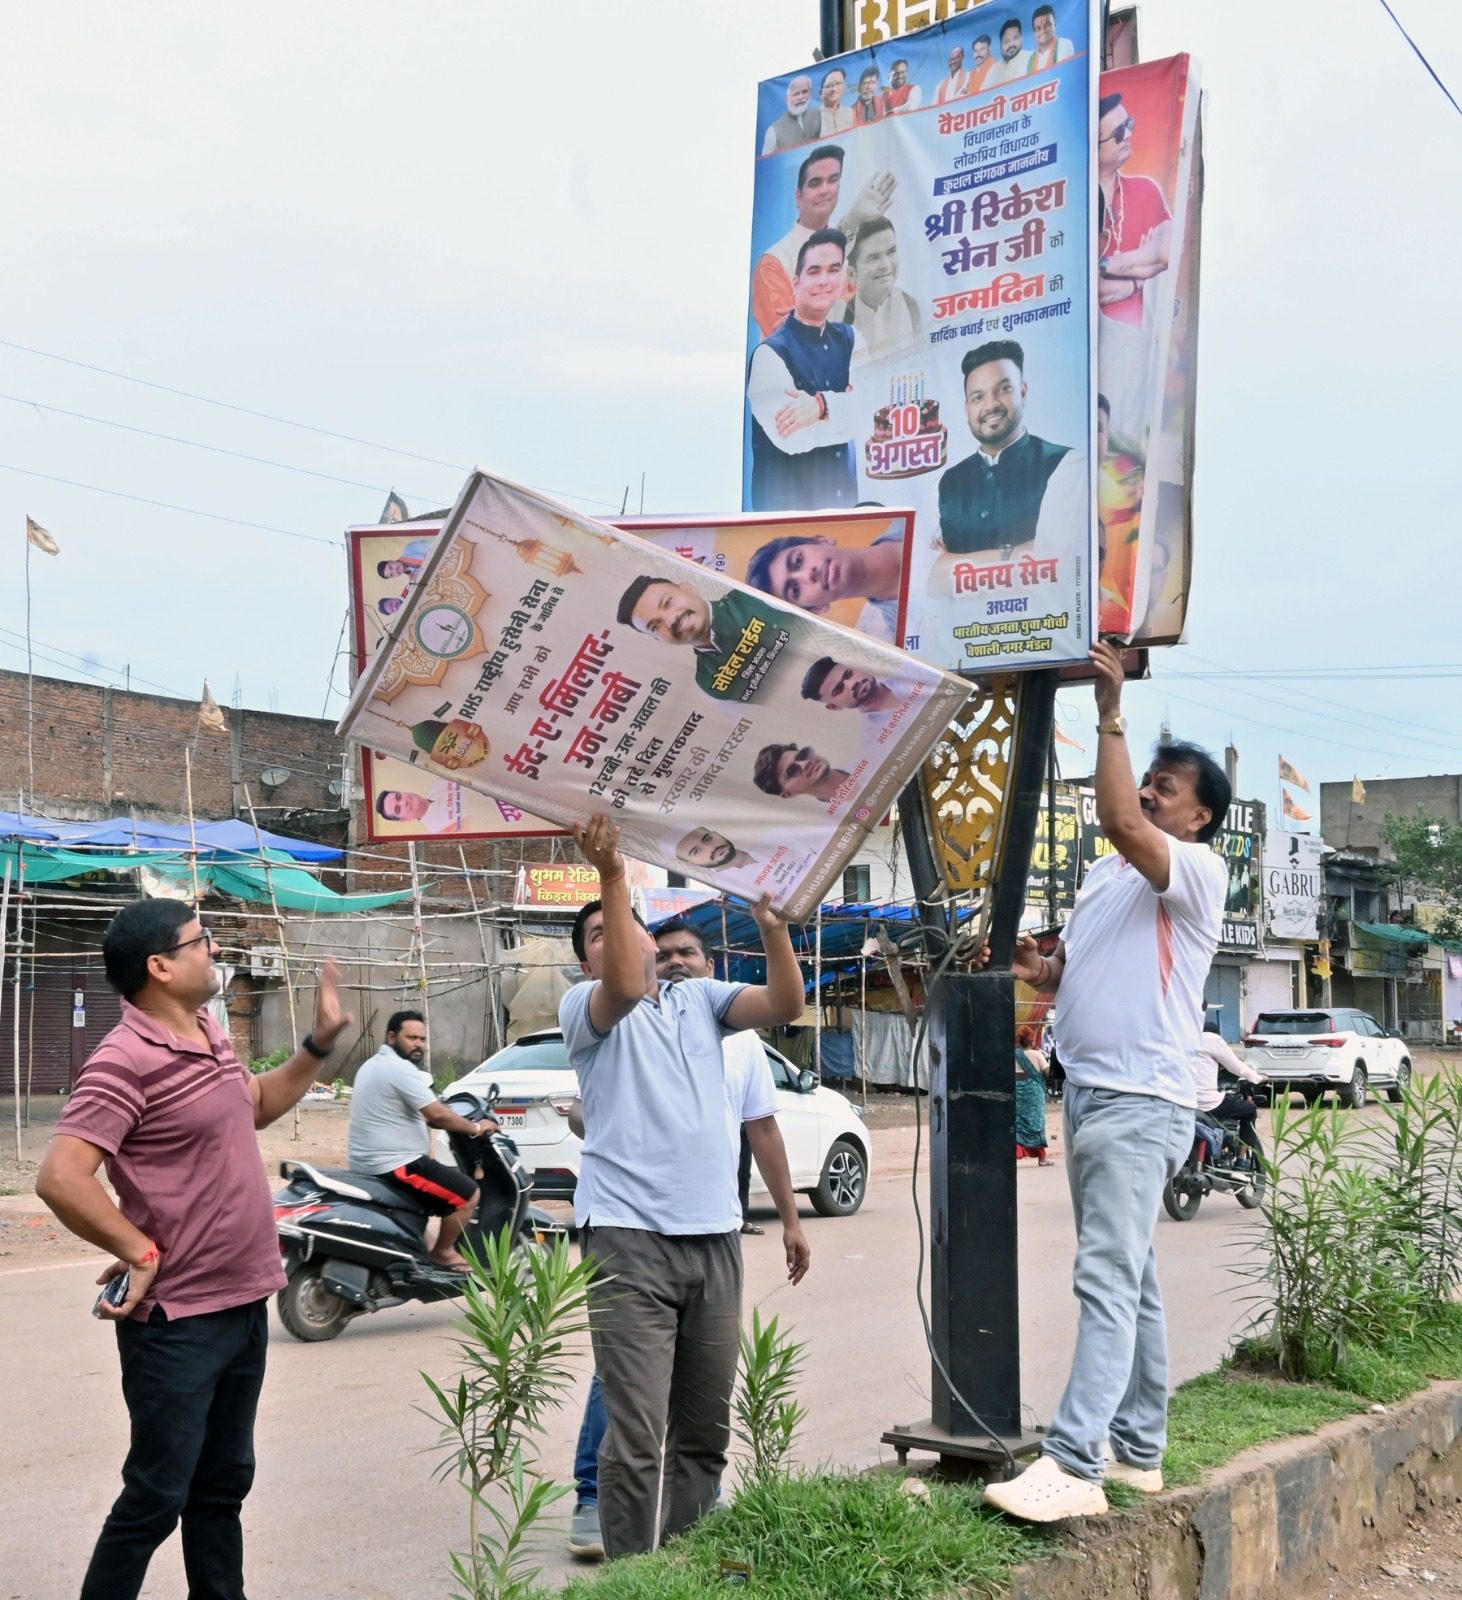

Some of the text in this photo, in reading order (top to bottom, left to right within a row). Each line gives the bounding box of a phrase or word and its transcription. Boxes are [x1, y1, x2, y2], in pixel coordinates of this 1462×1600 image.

[938, 80, 1058, 135] वैशाली नगर
[954, 133, 1040, 169] लोकप्रिय विधायक
[964, 115, 1032, 148] विधानसभा के
[943, 170, 972, 193] कुशल
[1008, 150, 1048, 175] माननीय
[925, 180, 1067, 242] श्री रिकेश
[942, 218, 1064, 276] सेन जी को
[933, 272, 1064, 319] जन्मदिन की
[930, 300, 1072, 344] हार्दिक बधाई एवं शुभकामनाएं
[890, 405, 919, 438] 10
[870, 435, 942, 473] अगस्त
[953, 562, 1012, 594] विनय
[1020, 557, 1059, 586] सेन
[528, 622, 544, 633] के
[550, 586, 565, 596] से
[953, 611, 1068, 639] भारतीय जनता युवा मोर्चा
[986, 597, 1028, 615] अध्यक्ष
[458, 692, 484, 720] RHS
[474, 650, 510, 692] राष्ट्रीय
[498, 609, 537, 654] हुसैनी
[518, 578, 550, 609] सेना
[711, 616, 766, 692] सोहेल राईन
[966, 636, 1052, 658] वैशाली नगर मंडल
[503, 645, 552, 715] आप सभी को
[740, 663, 756, 680] जिला
[504, 630, 614, 781] ईद-ए-मिलाद-
[562, 671, 643, 770] उन-नबी
[588, 780, 608, 797] 12
[650, 676, 672, 697] की
[639, 710, 705, 796] से मुबारकबाद
[688, 716, 754, 802] आमद मरहबा
[609, 736, 665, 810] की तहे दिल
[660, 746, 711, 814] सरकार की
[791, 893, 811, 916] JOIN
[805, 849, 842, 894] HUSSAINI
[835, 823, 858, 851] SENA
[1222, 834, 1252, 858] KIDS
[530, 866, 600, 886] शुभम रेडिमे
[1270, 871, 1318, 898] GABRU
[1222, 923, 1256, 946] LE KIDS
